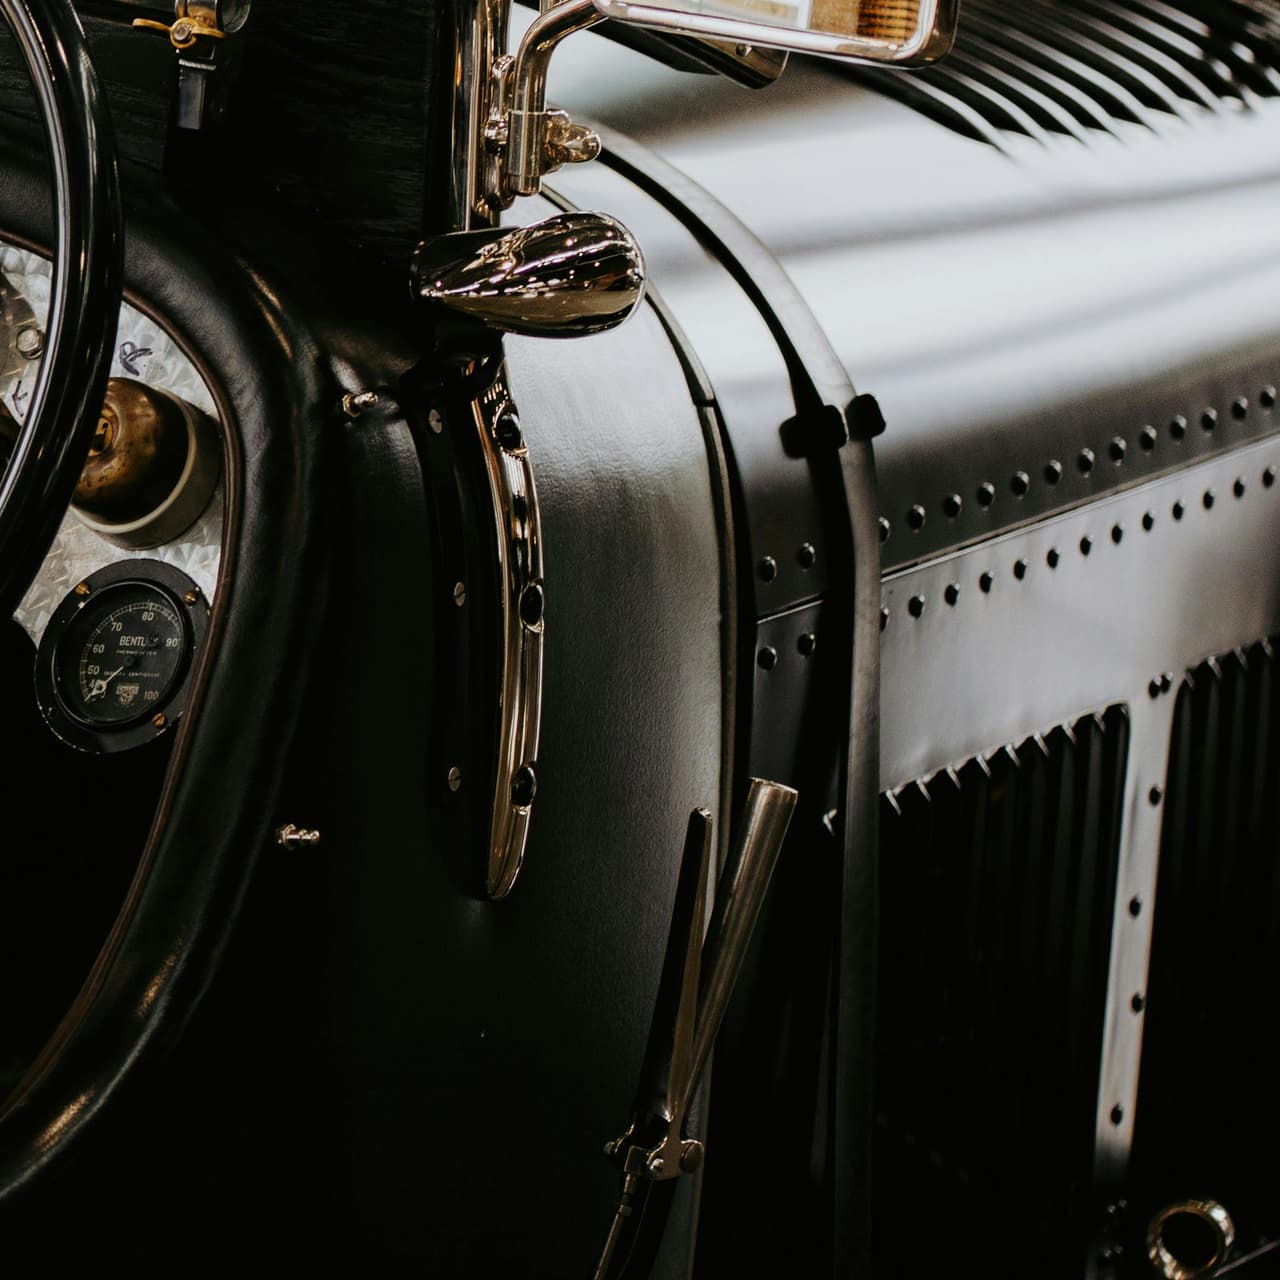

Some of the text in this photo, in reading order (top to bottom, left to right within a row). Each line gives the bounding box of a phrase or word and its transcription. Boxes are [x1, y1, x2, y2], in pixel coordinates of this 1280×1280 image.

[142, 611, 155, 621] 80
[111, 621, 123, 632] 70
[119, 635, 160, 648] BENTL
[165, 637, 178, 648] 90
[92, 644, 105, 654] 60
[87, 665, 100, 675] 50
[144, 690, 159, 700] 100
